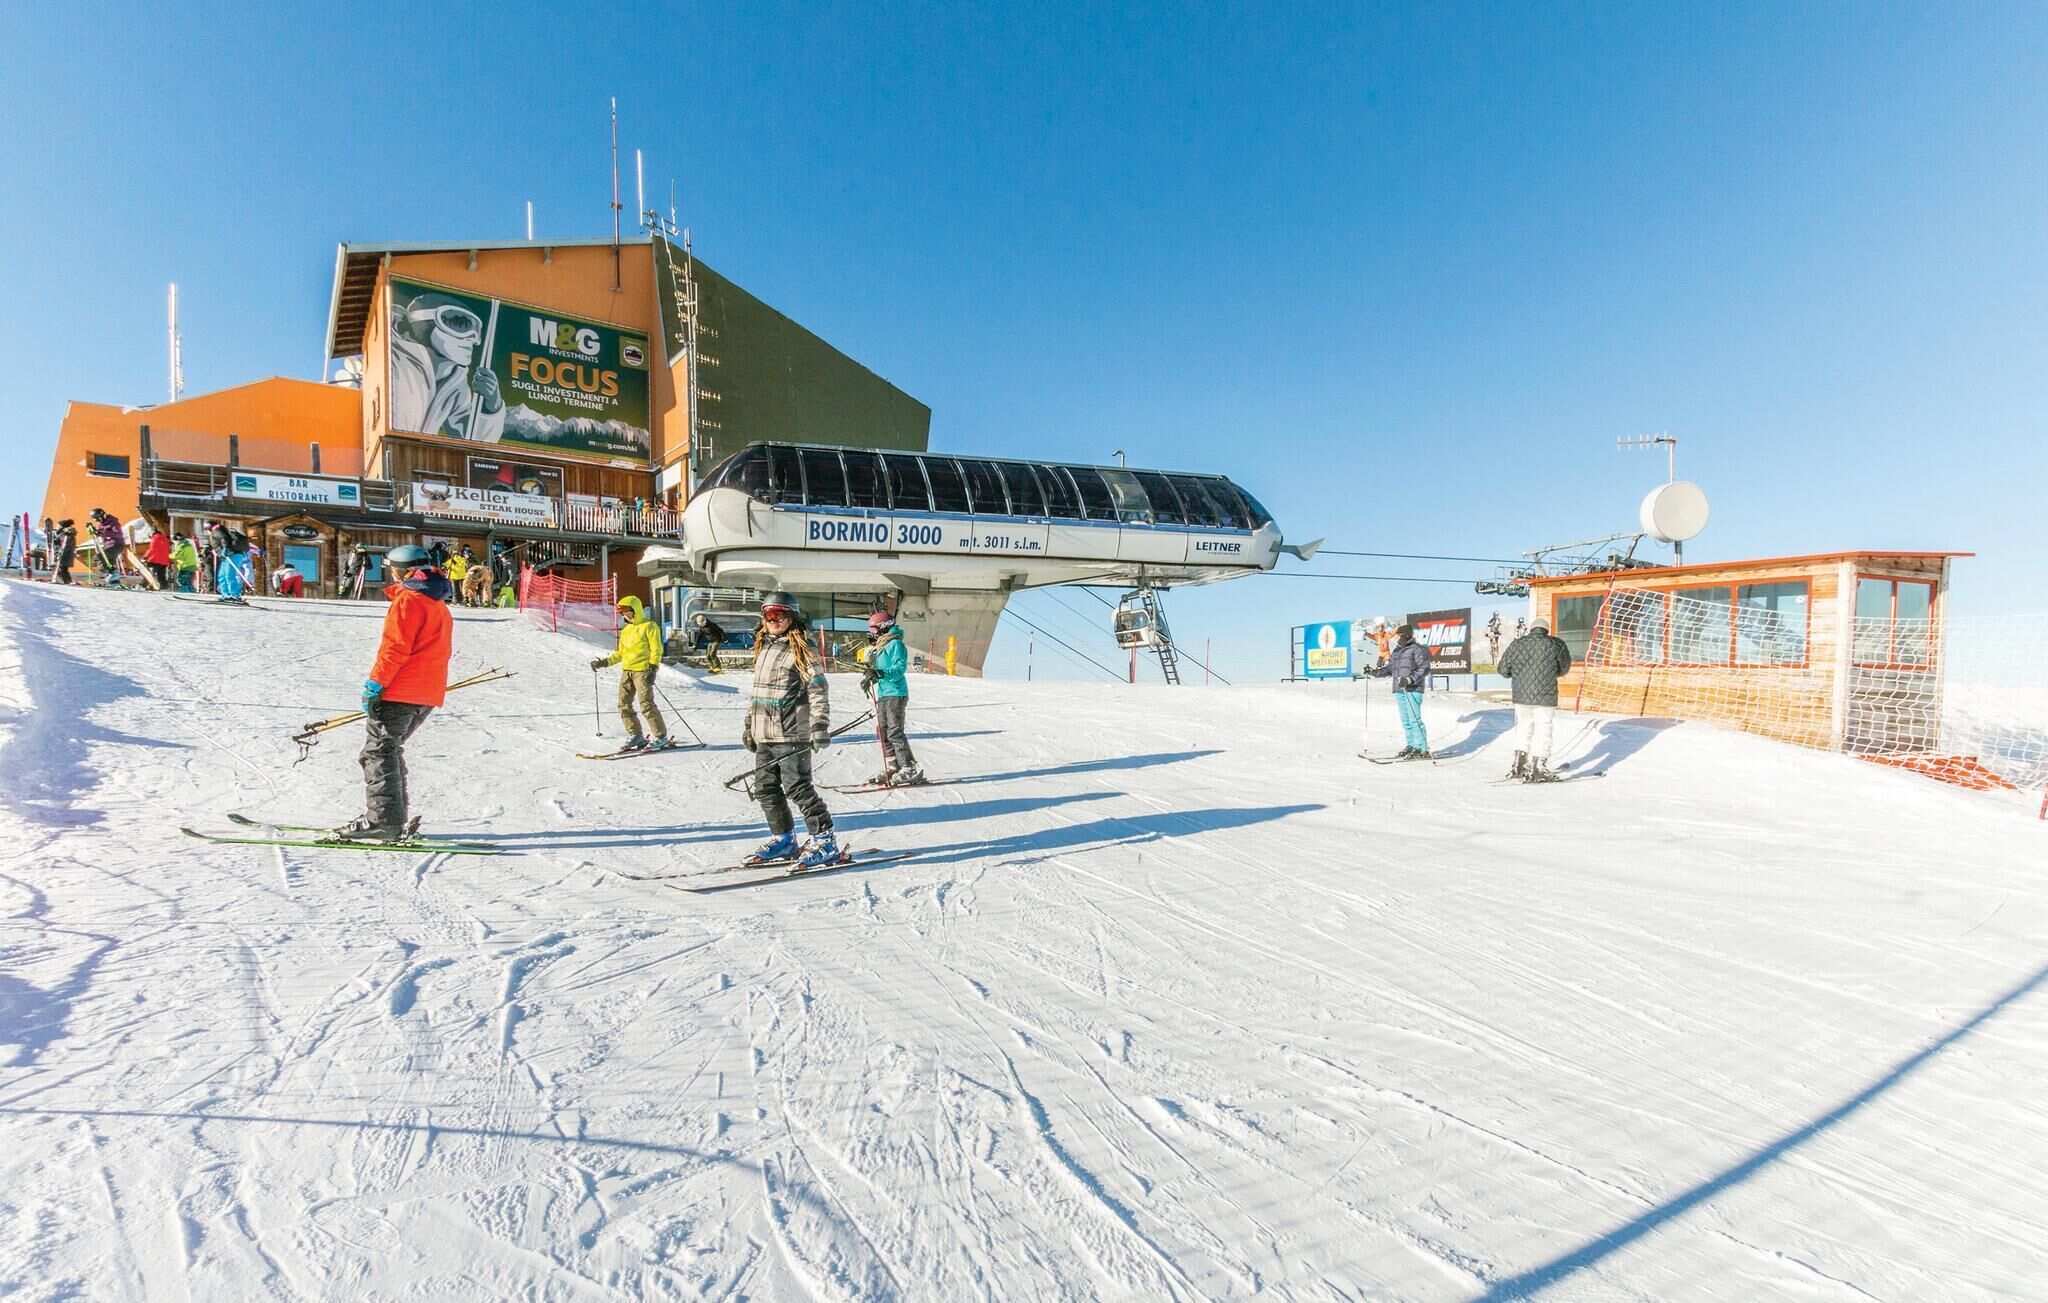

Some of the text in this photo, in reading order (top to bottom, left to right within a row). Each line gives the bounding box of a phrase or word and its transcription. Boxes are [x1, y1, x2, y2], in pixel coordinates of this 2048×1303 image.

[529, 316, 600, 355] M&G
[549, 348, 599, 363] INVESTMENTS
[511, 352, 619, 396] FOCUS
[511, 380, 619, 406] SUGLI INVESTIMENTI A
[528, 391, 604, 411] LUNGO TERMINE
[474, 462, 499, 470] SAMSUNG
[289, 478, 308, 489] BAR
[268, 490, 329, 503] RISTORANTE
[455, 487, 509, 504] Keller
[479, 503, 512, 513] STEAK
[514, 506, 546, 517] HOUSE
[809, 520, 942, 545] BORMIO 3000
[984, 536, 1009, 549] 3011
[1014, 537, 1041, 550] s.l.m.
[1196, 541, 1241, 552] LEITNER
[1321, 650, 1344, 658] SPORT
